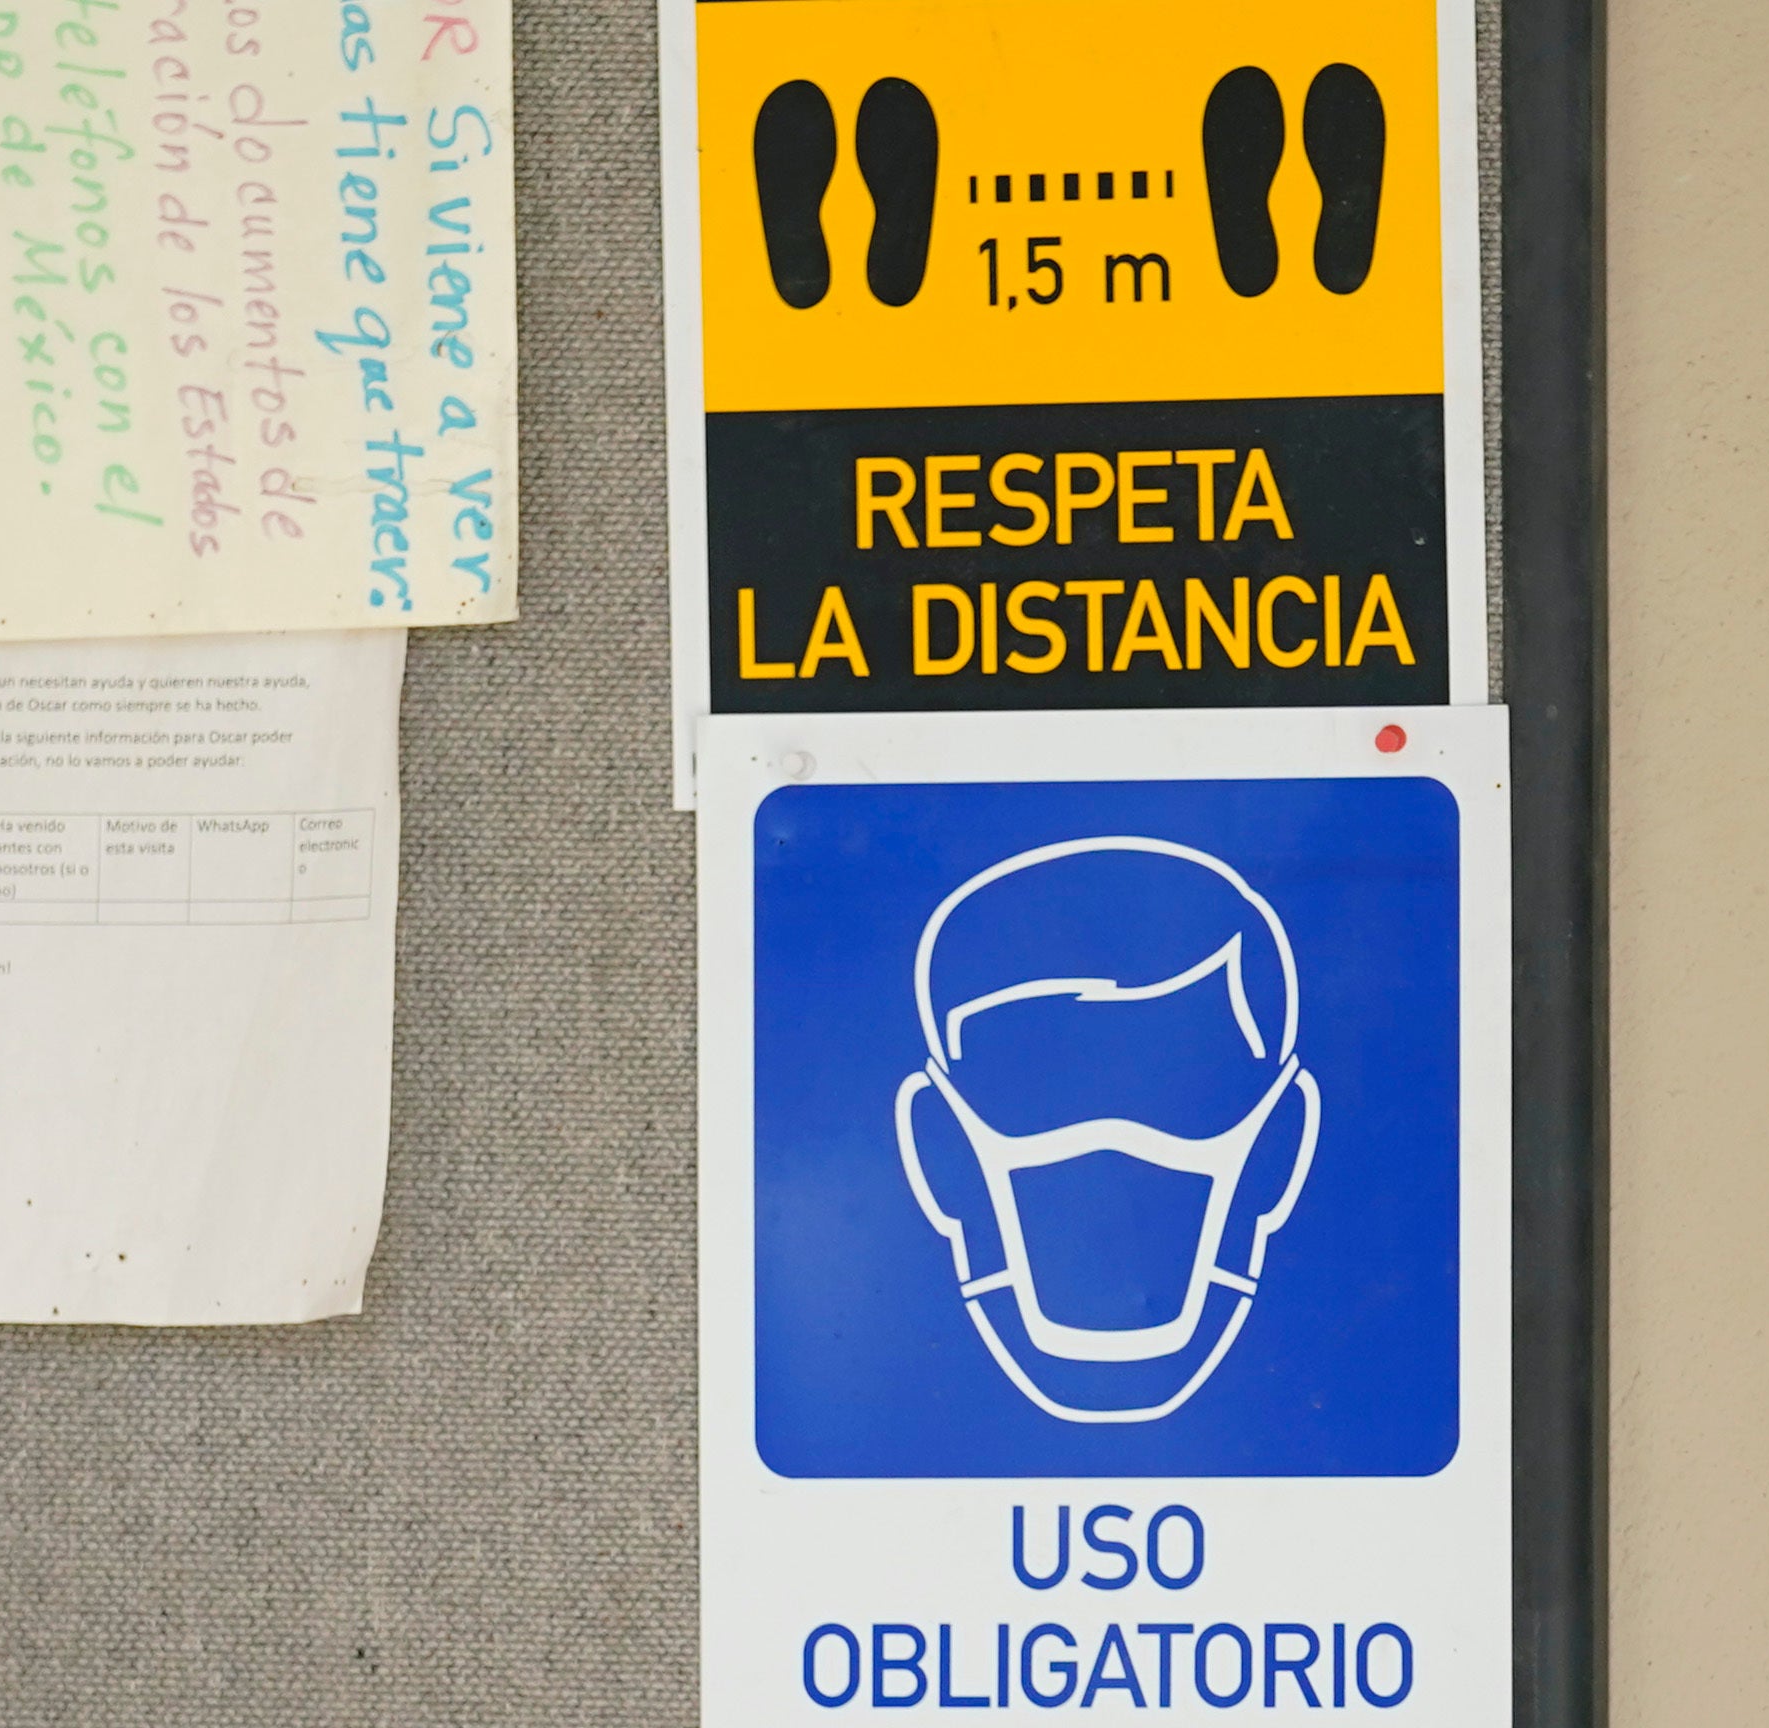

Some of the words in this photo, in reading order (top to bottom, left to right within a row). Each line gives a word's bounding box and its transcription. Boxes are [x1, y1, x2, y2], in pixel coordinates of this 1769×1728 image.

[224, 0, 261, 56] os
[340, 0, 376, 71] as
[421, 0, 478, 61] R
[0, 114, 48, 188] de
[428, 104, 489, 172] Si
[157, 193, 210, 252] de
[335, 95, 408, 285] tiene
[228, 83, 309, 449] documentos
[426, 196, 484, 369] viene
[976, 237, 1064, 312] 1,5
[1104, 248, 1172, 303] m
[161, 286, 225, 357] los
[11, 229, 76, 496] México.
[89, 331, 132, 432] con
[313, 306, 395, 414] que
[438, 395, 477, 436] a
[94, 462, 165, 527] el
[177, 384, 242, 558] Estados
[259, 466, 318, 541] de
[854, 448, 1295, 551] RESPETA
[365, 428, 425, 612] traer:
[448, 467, 494, 594] ver
[737, 586, 871, 680] LA
[912, 573, 1416, 678] DISTANCIA
[6, 698, 24, 712] de
[29, 699, 67, 712] Oscar
[72, 701, 112, 712] como
[116, 699, 171, 715] siempre
[176, 702, 190, 712] se
[196, 699, 213, 712] ha
[217, 698, 261, 712] hecho.
[20, 675, 87, 689] necesitan
[91, 675, 132, 691] ayuda
[137, 678, 145, 691] y
[149, 676, 203, 691] quieren
[208, 676, 259, 689] nuestra
[263, 676, 310, 691] ayuda,
[0, 731, 13, 744] la
[16, 731, 80, 748] siguiente
[85, 730, 170, 744] información
[174, 734, 205, 748] para
[209, 731, 248, 745] Oscar
[251, 730, 293, 747] poder
[46, 757, 64, 768] no
[69, 755, 81, 768] lo
[85, 758, 132, 768] vamos
[134, 758, 143, 768] a
[148, 755, 189, 770] poder
[17, 819, 66, 833] venido
[36, 844, 62, 855] con
[105, 843, 135, 855] esta
[139, 841, 175, 855] visita
[106, 819, 157, 833] Motivo
[160, 819, 178, 834] de
[197, 819, 270, 833] WhatsApp
[299, 817, 343, 831] Correo
[80, 866, 89, 877] o
[299, 864, 307, 875] o
[1010, 1503, 1206, 1592] USO
[801, 1621, 1414, 1709] OBLIGATORIO
